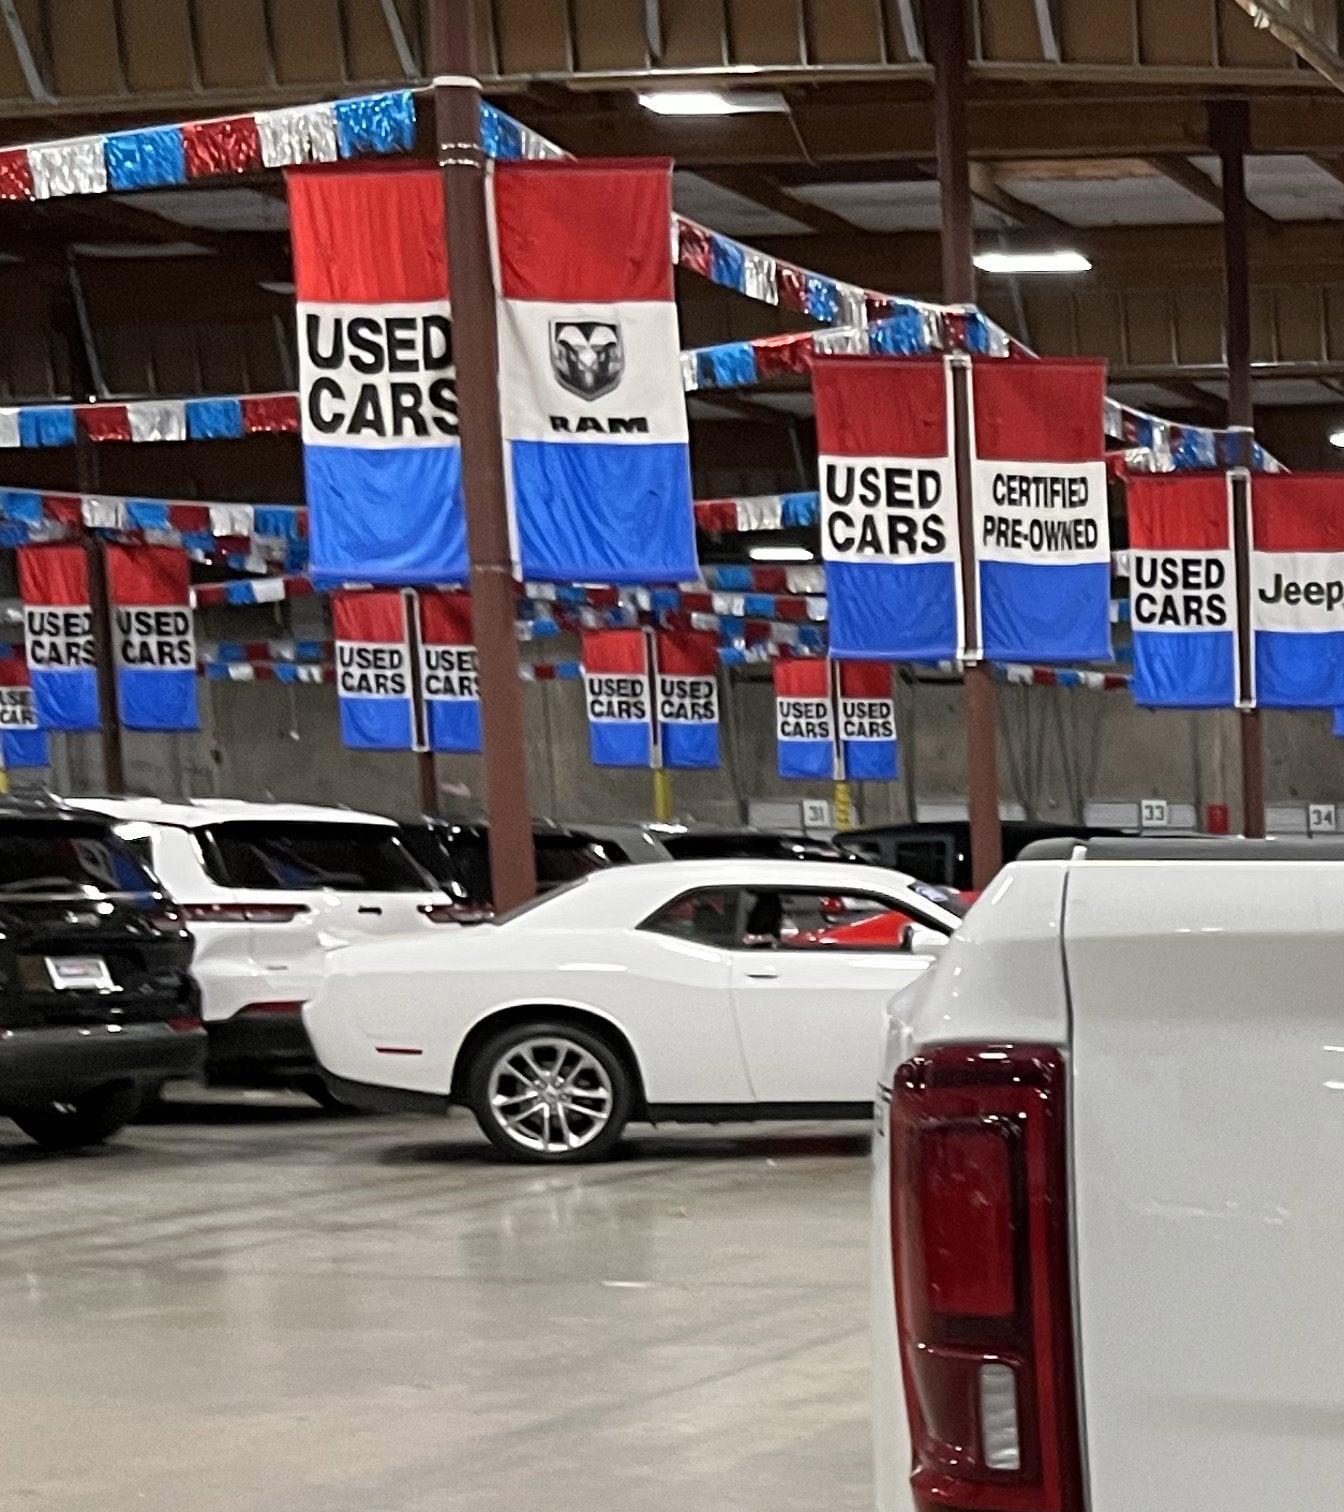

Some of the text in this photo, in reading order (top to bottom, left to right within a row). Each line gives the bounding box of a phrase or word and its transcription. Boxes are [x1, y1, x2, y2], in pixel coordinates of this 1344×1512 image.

[306, 313, 452, 374] USED
[309, 378, 459, 437] CARS
[549, 415, 649, 434] RAM
[826, 464, 942, 510] USED
[992, 473, 1089, 508] CERTIFIED
[828, 511, 946, 555] CARS
[983, 515, 1098, 551] PRE-OWNED
[1135, 556, 1225, 590] USED
[1258, 573, 1344, 611] Jeep
[1135, 592, 1227, 626] CARS
[116, 612, 189, 637] USED
[122, 640, 191, 664] CARS
[339, 647, 403, 669] USED
[341, 672, 405, 694] CARS
[589, 678, 643, 697] USED
[660, 679, 713, 699] USED
[590, 700, 646, 719] CARS
[661, 700, 715, 720] CARS
[780, 702, 827, 718] USED
[843, 702, 890, 719] USED
[781, 721, 830, 737] CARS
[844, 721, 893, 737] CARS
[1144, 804, 1165, 821] 33
[1312, 809, 1332, 826] 34
